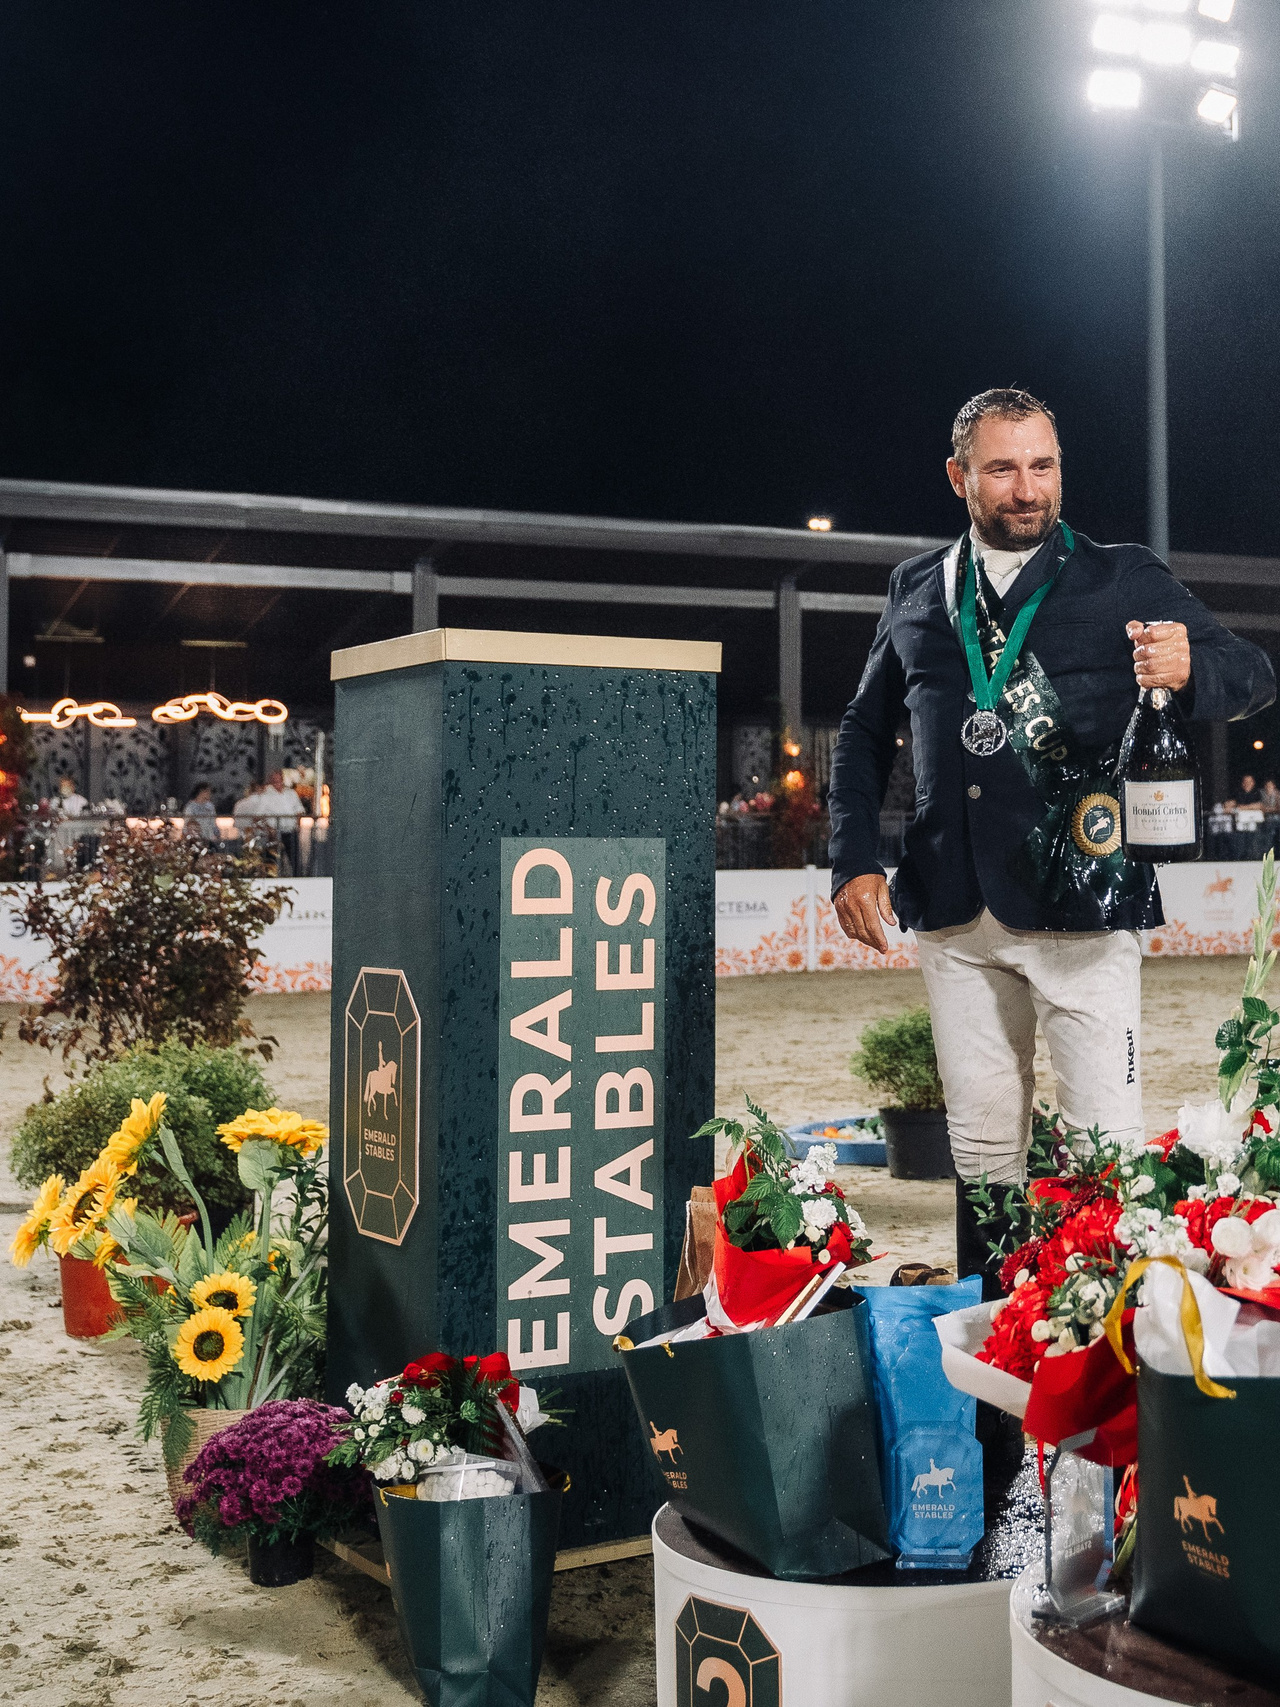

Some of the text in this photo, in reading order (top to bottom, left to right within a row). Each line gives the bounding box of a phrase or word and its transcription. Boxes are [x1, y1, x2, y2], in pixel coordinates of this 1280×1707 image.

[1025, 716, 1068, 764] CUP
[508, 847, 574, 1371] EMERALD
[593, 872, 657, 1337] STABLES
[364, 1128, 396, 1146] EMERALD
[365, 1143, 395, 1161] STABLES
[664, 1471, 688, 1480] ERALD
[914, 1511, 954, 1519] STABLES
[1181, 1540, 1229, 1567] EMERALD
[1187, 1553, 1230, 1578] STABLES
[697, 1657, 746, 1707] 2
